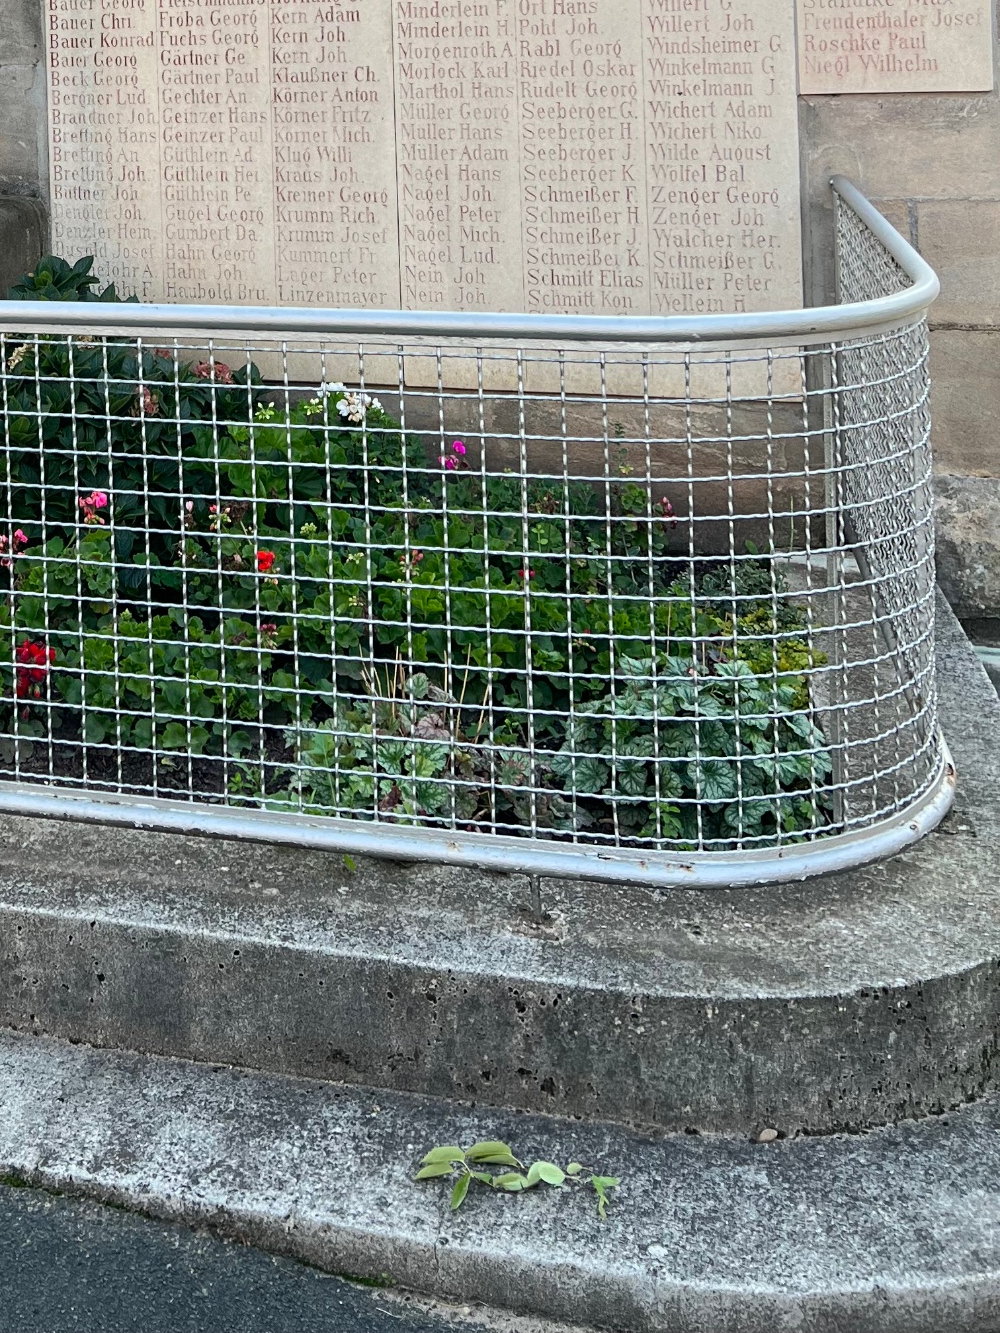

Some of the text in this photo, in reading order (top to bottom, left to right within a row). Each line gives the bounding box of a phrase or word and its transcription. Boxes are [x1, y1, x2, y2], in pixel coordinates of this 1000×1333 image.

[271, 6, 361, 24] Kern Adam
[519, 0, 547, 16] Ort
[49, 32, 154, 49] Bauer Konrad
[159, 29, 259, 48] Fuchs Georg
[272, 27, 309, 44] Kern
[804, 31, 927, 52] Roschke Paul
[161, 68, 260, 86] Gärtner Paul
[272, 67, 348, 84] Klaußner
[399, 62, 509, 81] Morlock Karl
[583, 60, 638, 78] Oskar
[51, 70, 139, 90] Beck Georg
[273, 86, 378, 104] Körner Anton
[649, 100, 773, 119] Wichert Adam
[274, 146, 352, 166] Klug Willi
[275, 186, 388, 208] Kreiner Georg
[652, 186, 780, 209] Zenger Georg
[165, 205, 264, 225] Gugel Georg
[276, 205, 334, 223] Krumm
[333, 266, 378, 285] Peter
[600, 270, 644, 288] Elias
[654, 273, 773, 292] Müller Peter
[167, 281, 232, 300] Haubold
[278, 282, 388, 306] Linzenmayer
